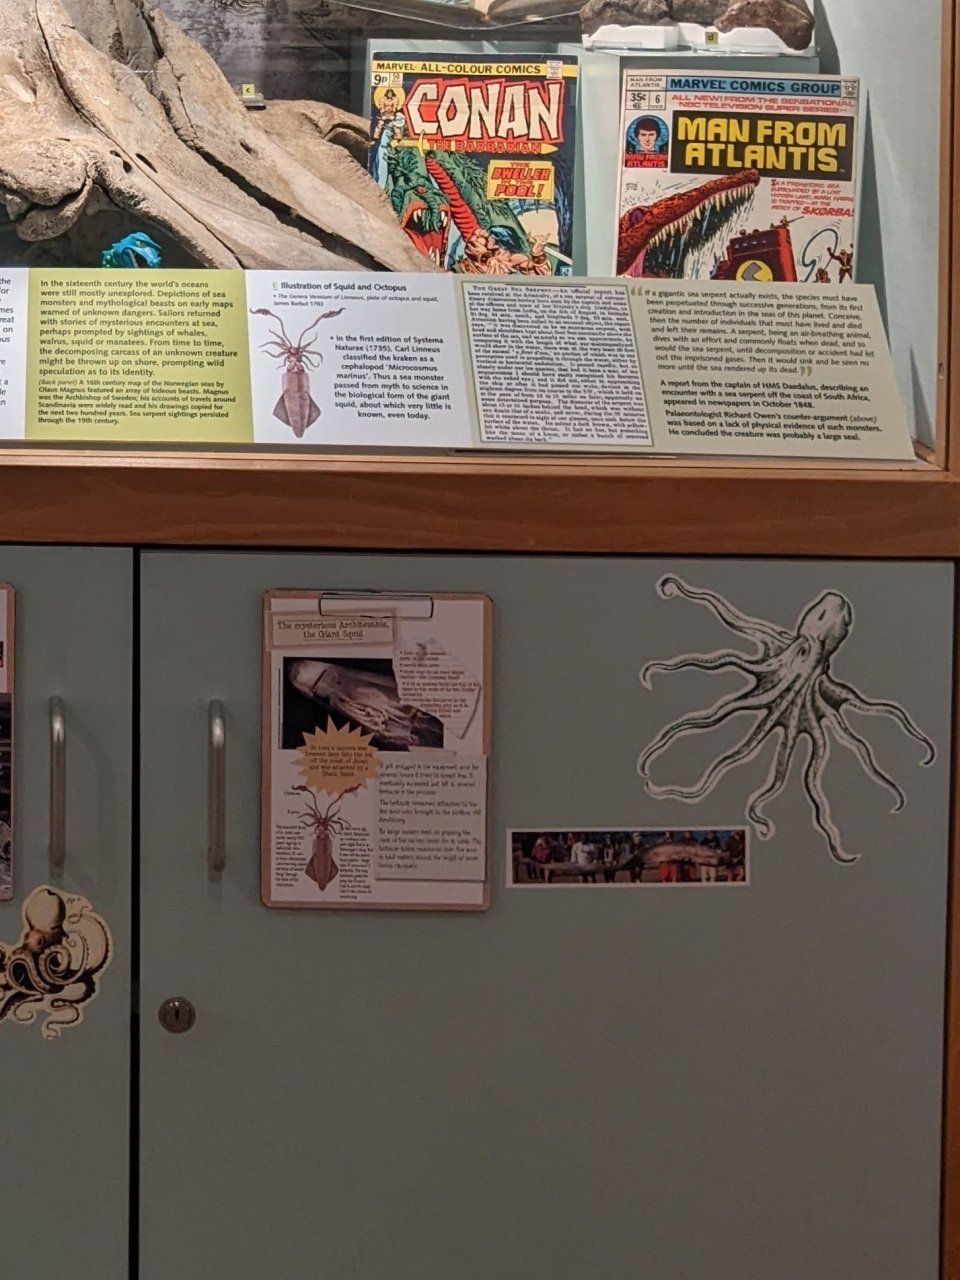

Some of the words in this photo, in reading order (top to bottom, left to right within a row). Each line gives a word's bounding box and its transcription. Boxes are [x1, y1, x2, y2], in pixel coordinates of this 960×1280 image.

[376, 63, 414, 71] MARVEL
[421, 63, 492, 74] ALL-COLOUR
[496, 64, 542, 74] COMICS
[373, 74, 388, 86] 9p
[670, 79, 727, 91] MARVEL
[730, 81, 785, 93] COMICS
[791, 82, 840, 94] GROUP
[655, 94, 661, 104] 6
[406, 82, 562, 141] CONAN
[678, 117, 750, 143] MAN
[757, 120, 847, 147] FROM
[455, 140, 542, 154] BARBARIAN
[684, 142, 839, 172] ATLANTIS
[491, 167, 551, 180] DWELLER
[495, 184, 543, 198] POOL!
[40, 279, 48, 287] In
[50, 279, 63, 287] the
[65, 279, 101, 287] sixteenth
[104, 280, 133, 289] century
[135, 280, 148, 288] the
[150, 280, 179, 288] world's
[281, 282, 321, 290] Illustration
[323, 282, 331, 291] of
[333, 282, 355, 293] Squid
[357, 283, 371, 291] and
[373, 283, 406, 293] Octopus
[336, 334, 343, 342] In
[345, 334, 356, 342] the
[376, 335, 401, 343] edition
[403, 335, 410, 343] of
[413, 335, 443, 345] Systema
[660, 379, 665, 387] A
[667, 379, 689, 389] report
[691, 380, 709, 388] from
[710, 380, 722, 388] the
[724, 381, 751, 391] captain
[752, 381, 760, 389] of
[781, 382, 818, 392] Daedalus,
[819, 383, 858, 393] describing
[294, 621, 336, 632] mysterious
[318, 630, 340, 639] Giant
